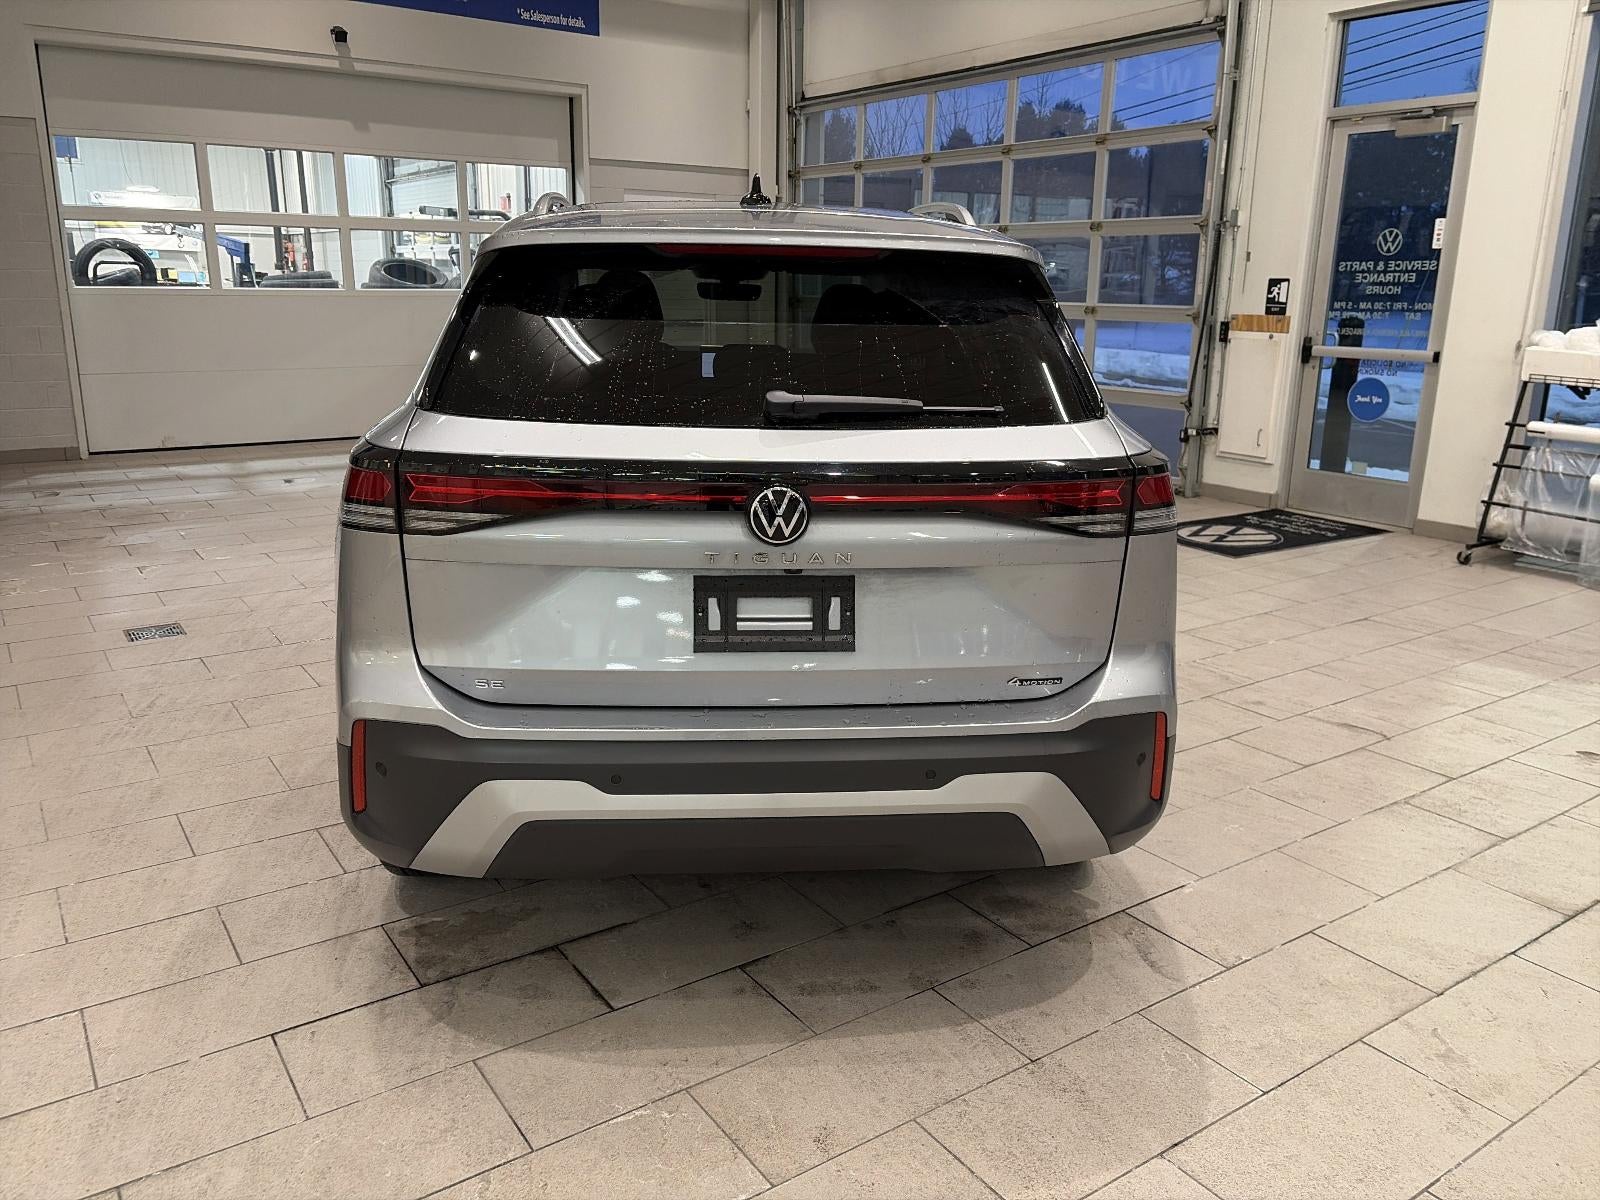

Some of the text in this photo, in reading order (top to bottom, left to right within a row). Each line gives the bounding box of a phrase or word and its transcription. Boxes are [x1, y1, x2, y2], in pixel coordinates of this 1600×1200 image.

[520, 8, 586, 28] See Salesperson for details.
[750, 486, 808, 543] VW
[704, 551, 853, 564] TIGUAN
[475, 679, 505, 689] SE
[1007, 677, 1062, 687] 4MOTION
